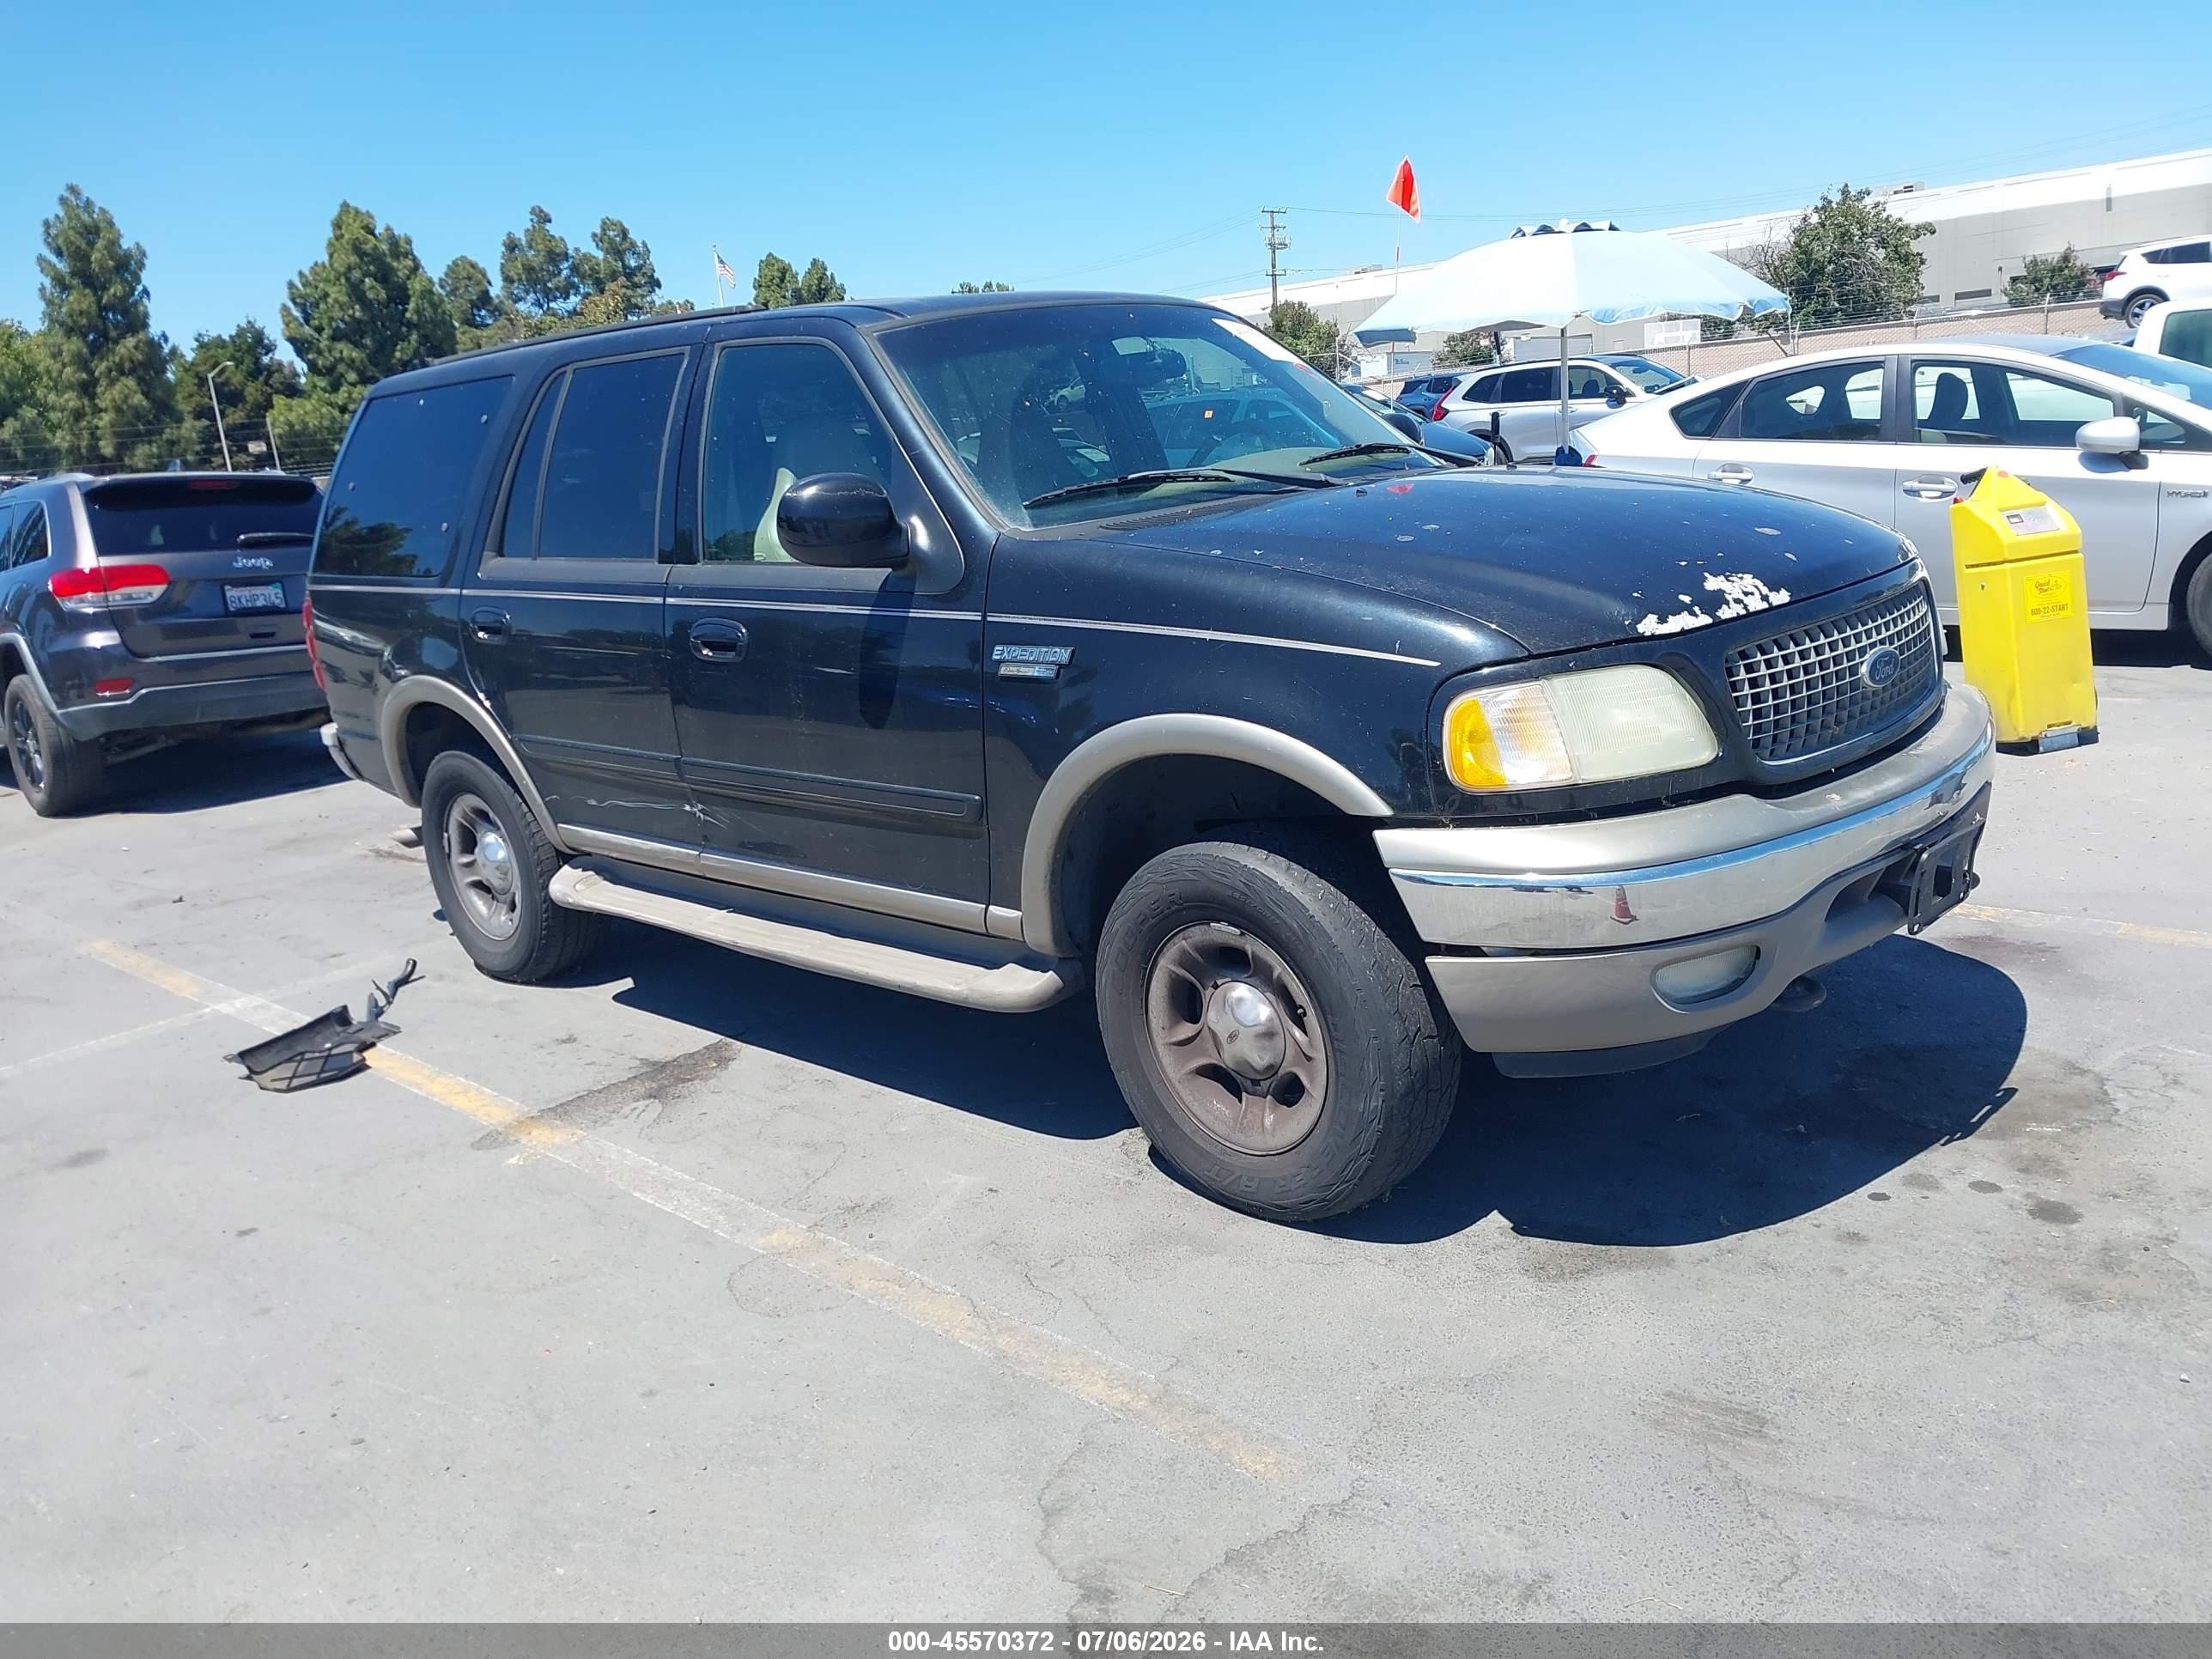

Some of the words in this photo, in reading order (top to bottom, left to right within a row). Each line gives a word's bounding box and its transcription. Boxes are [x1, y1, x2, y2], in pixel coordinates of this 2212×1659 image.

[232, 556, 274, 569] Jeep
[993, 646, 1073, 663] EXPEDITION
[1875, 656, 1895, 681] Ford
